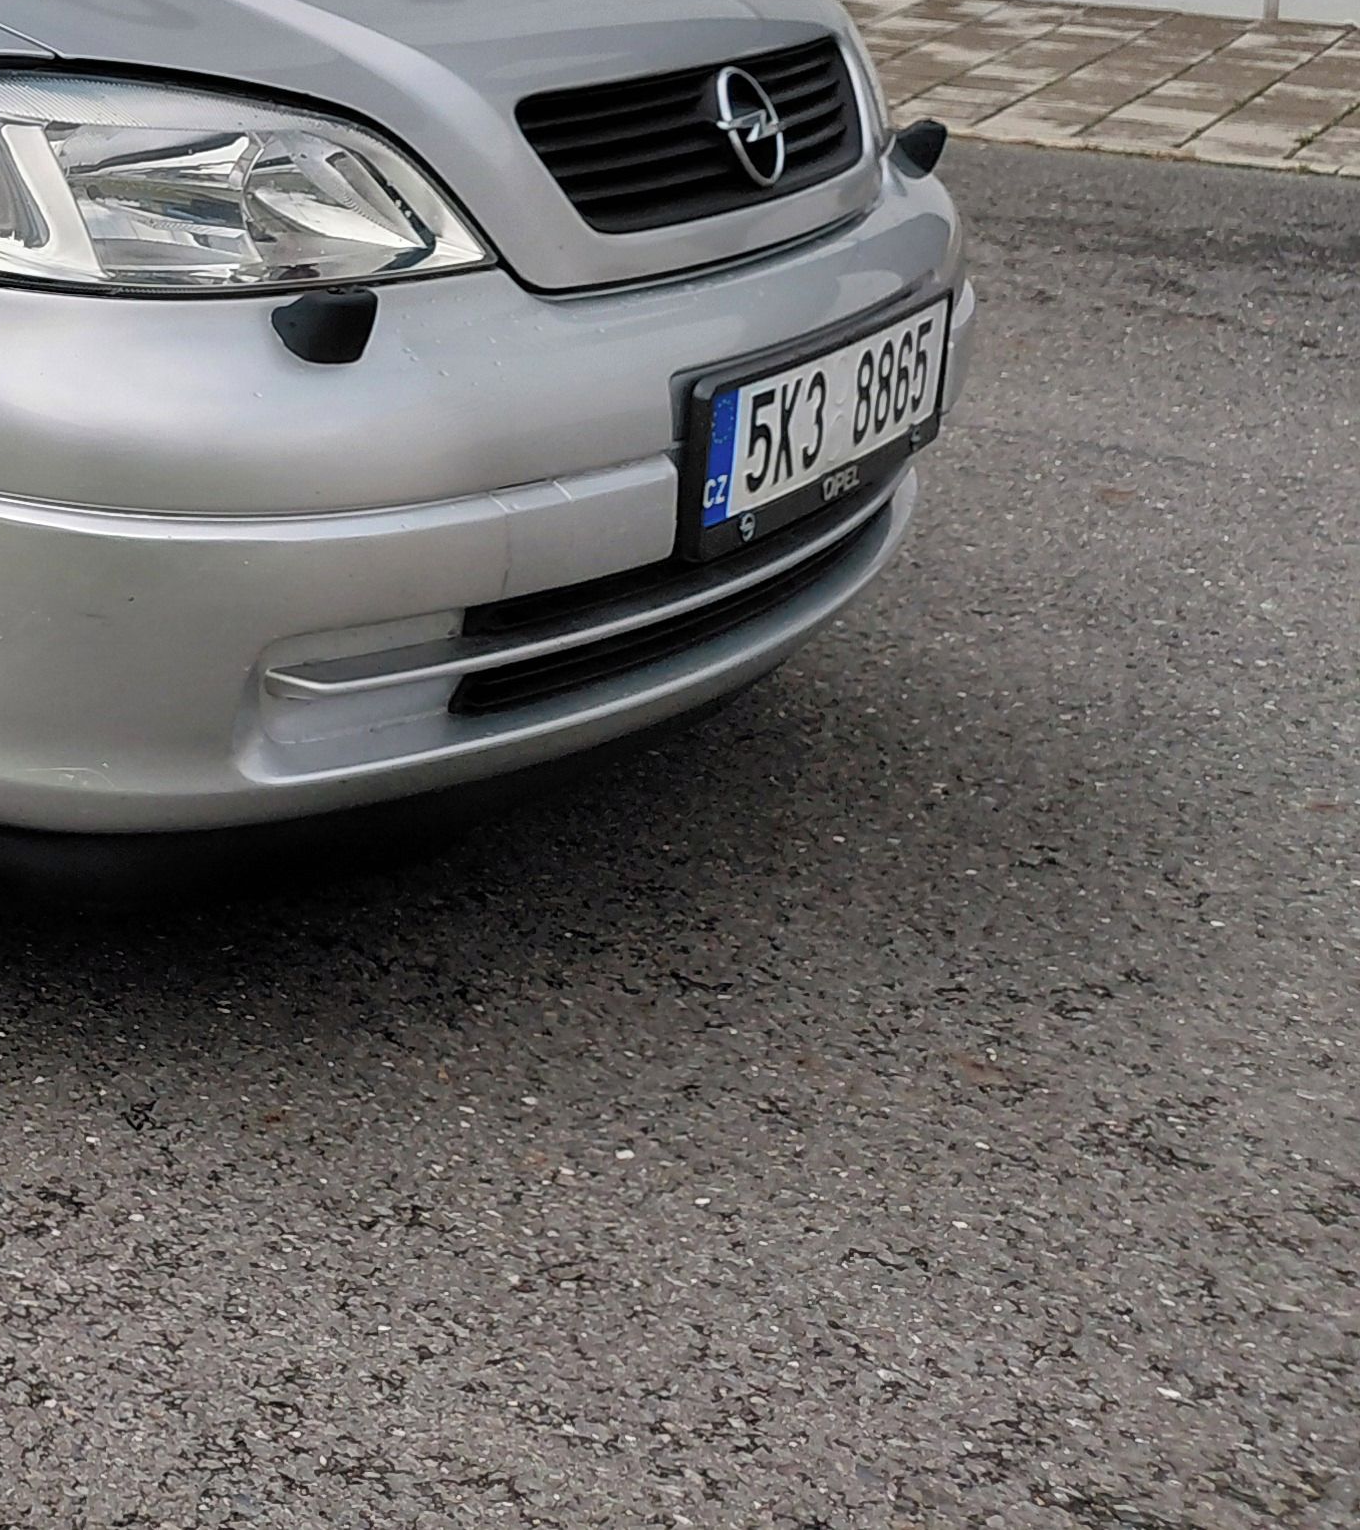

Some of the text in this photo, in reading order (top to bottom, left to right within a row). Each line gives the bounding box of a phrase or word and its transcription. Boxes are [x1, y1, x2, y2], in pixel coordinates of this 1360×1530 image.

[745, 318, 934, 494] 5K3 8865
[702, 474, 729, 508] CZ
[823, 465, 860, 501] OPEL
